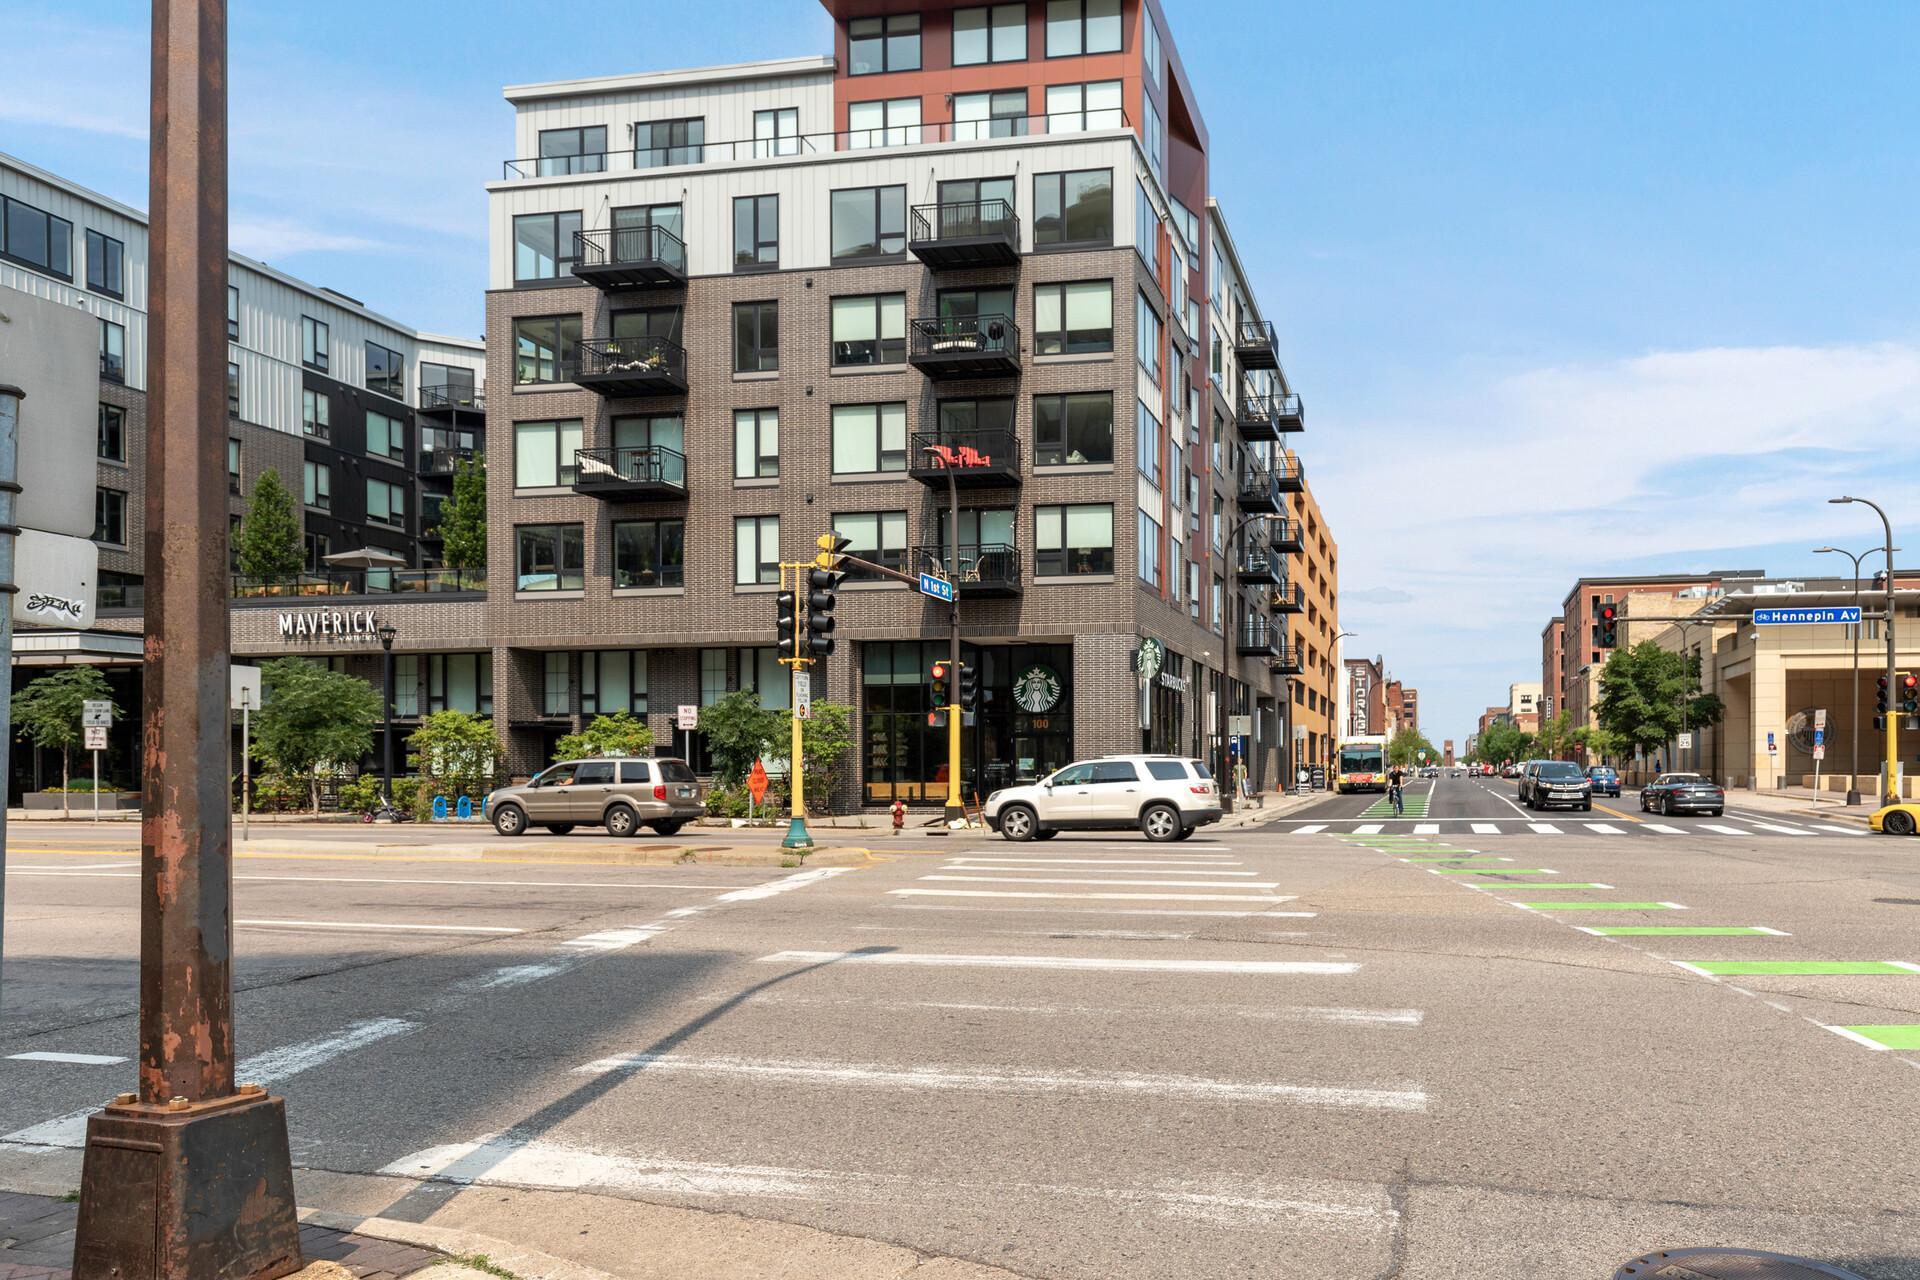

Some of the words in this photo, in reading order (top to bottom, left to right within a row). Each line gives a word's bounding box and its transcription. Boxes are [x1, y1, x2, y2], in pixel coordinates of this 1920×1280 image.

[923, 578, 929, 590] N
[931, 581, 940, 594] 1st
[941, 584, 949, 597] St
[279, 611, 376, 635] MAVERICK
[1772, 611, 1834, 622] Hennepin
[1840, 610, 1858, 621] Av
[1161, 671, 1186, 692] STARBUCKS
[1033, 719, 1049, 729] 100
